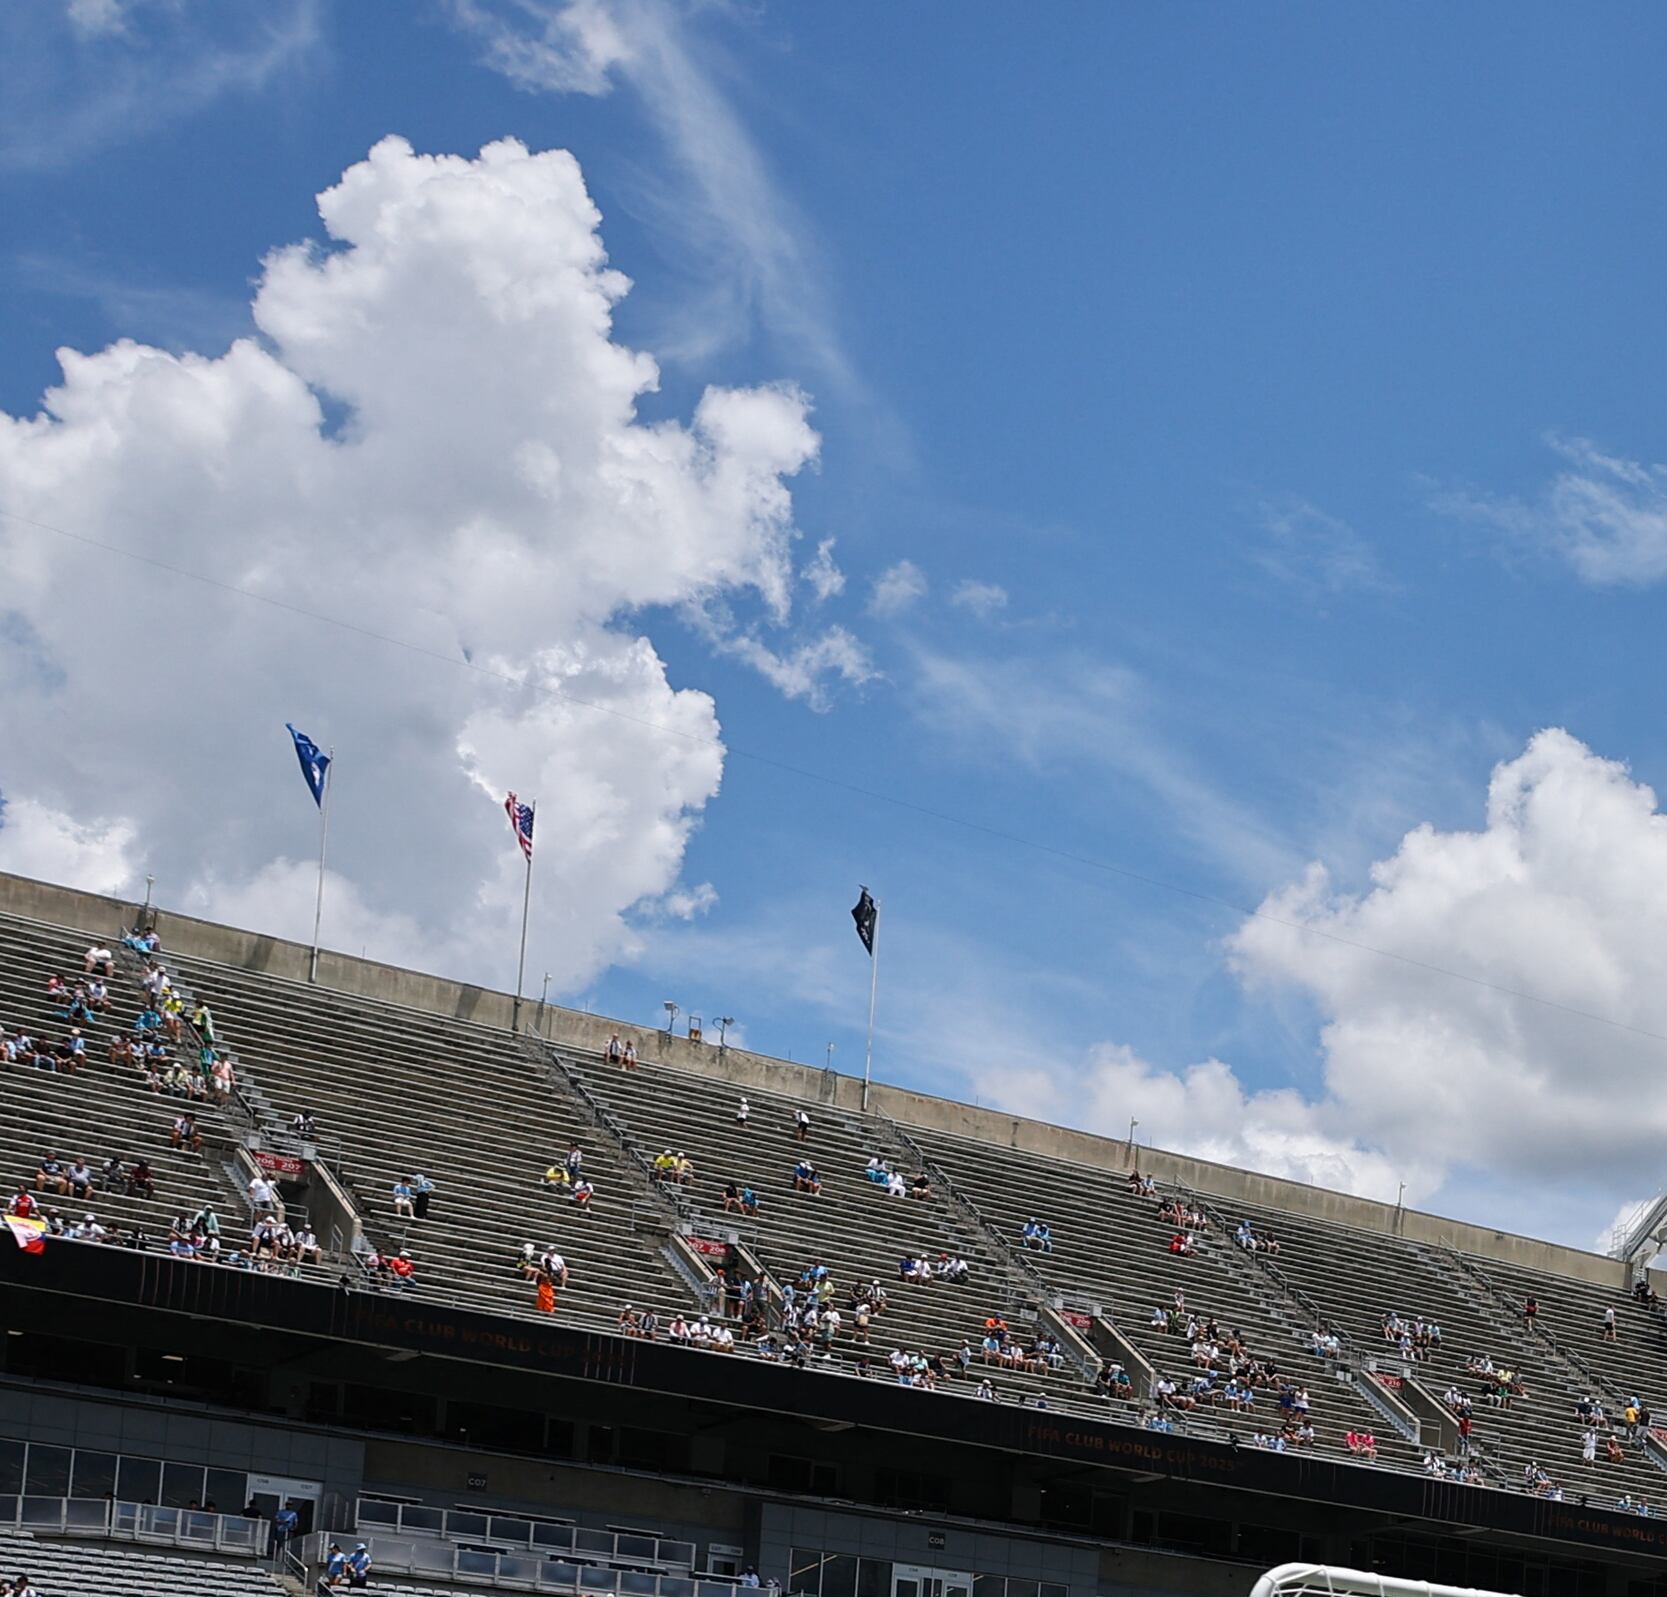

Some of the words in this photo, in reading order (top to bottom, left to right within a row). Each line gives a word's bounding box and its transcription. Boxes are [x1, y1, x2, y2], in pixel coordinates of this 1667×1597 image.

[1064, 1431, 1105, 1449] CLUB
[1108, 1438, 1162, 1460] WORLD
[1577, 1519, 1609, 1536] CLUB
